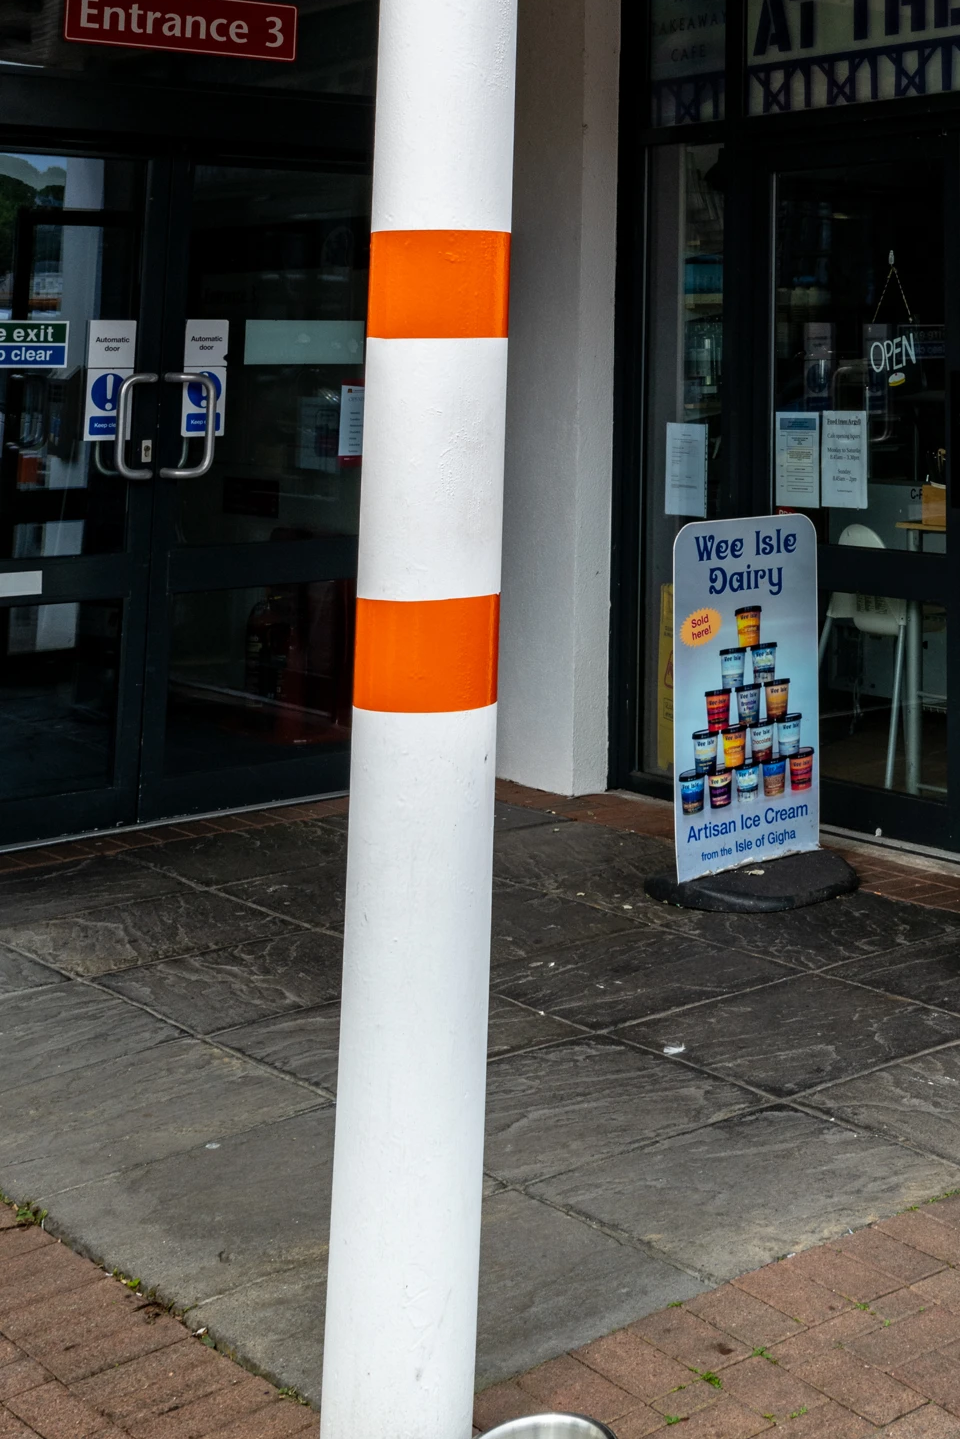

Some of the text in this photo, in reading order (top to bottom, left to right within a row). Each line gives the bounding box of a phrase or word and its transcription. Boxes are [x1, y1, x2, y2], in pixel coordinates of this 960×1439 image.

[265, 16, 284, 48] 3
[670, 44, 706, 63] CAFE
[13, 325, 55, 342] exit
[96, 336, 130, 344] Automatic
[191, 335, 223, 343] Automatic
[11, 347, 53, 362] clear
[871, 333, 917, 372] OPEN
[694, 528, 798, 562] Wee Isle
[708, 565, 784, 596] Dairy
[691, 613, 709, 632] Sold
[692, 625, 713, 641] here!
[687, 801, 809, 843] Artisan Ice Cream
[701, 828, 797, 861] from the Isle of Gigha
